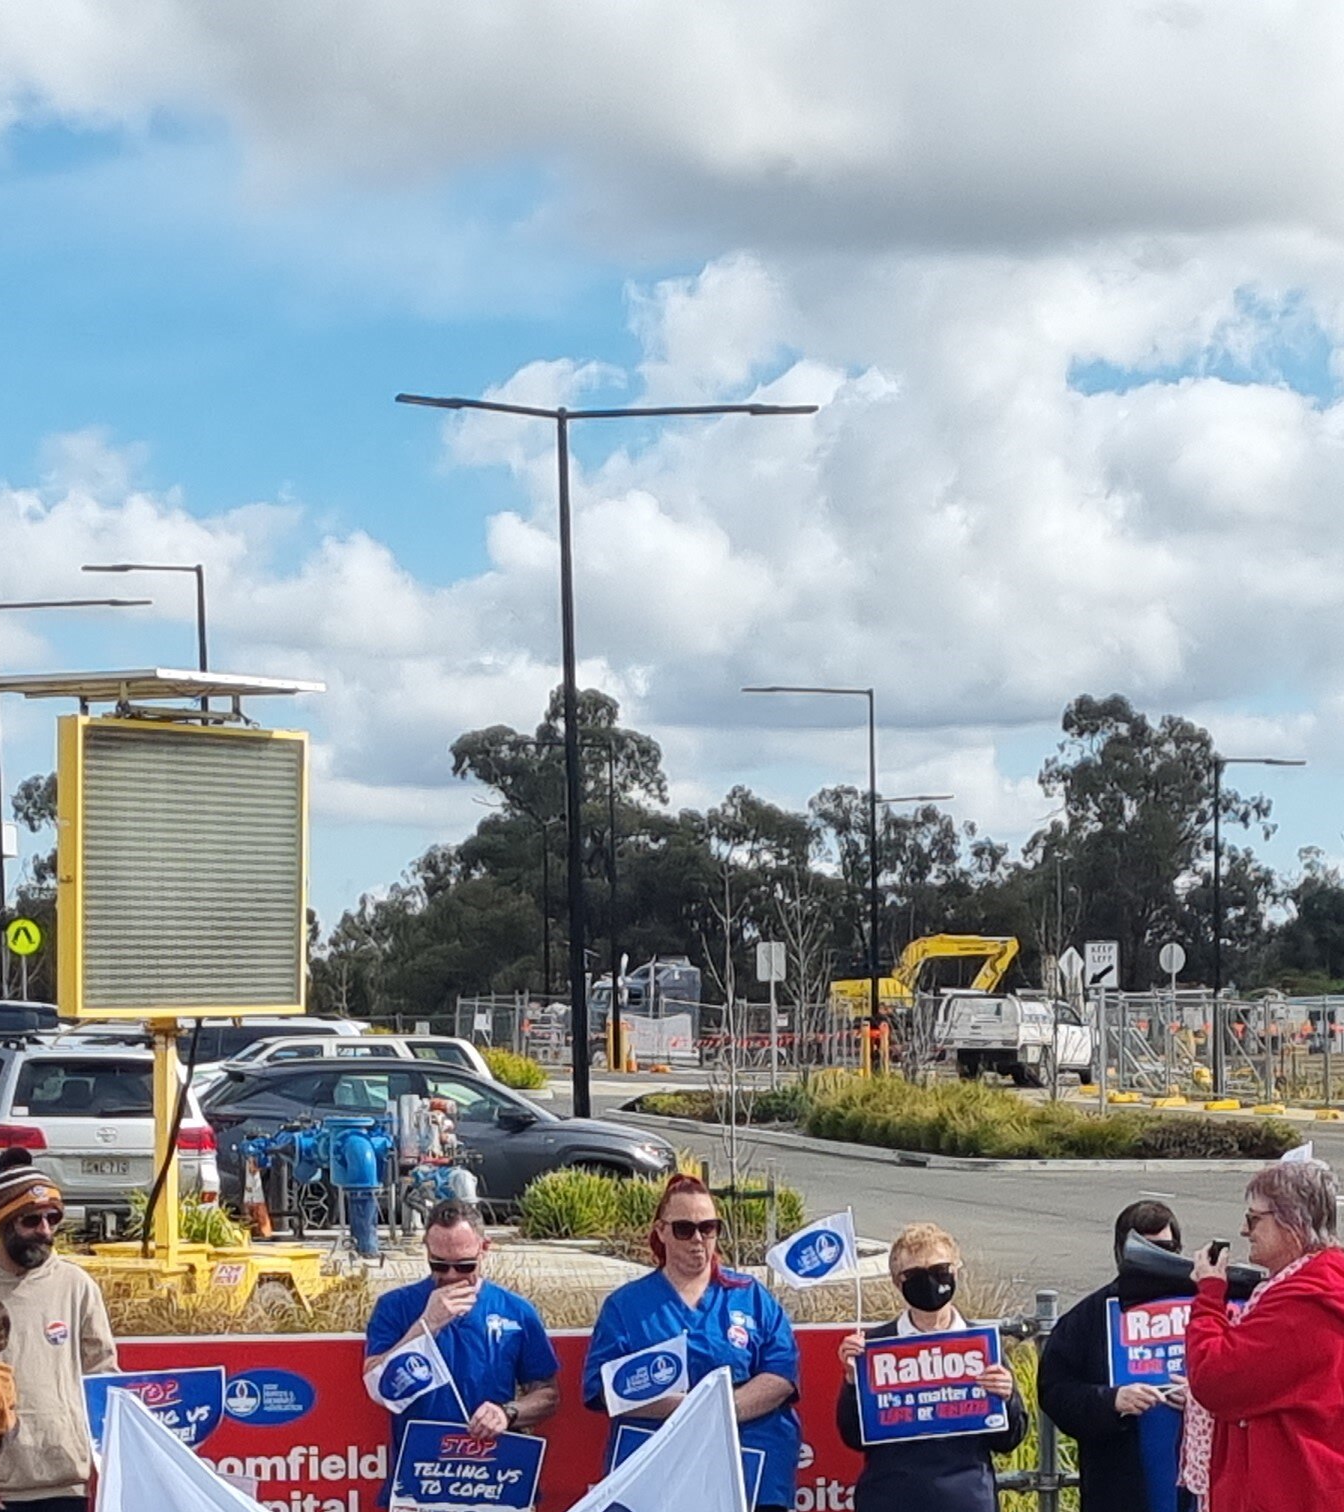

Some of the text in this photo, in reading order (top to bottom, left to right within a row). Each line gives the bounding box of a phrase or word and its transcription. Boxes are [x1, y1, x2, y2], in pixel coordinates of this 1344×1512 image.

[1091, 945, 1114, 953] KEEP
[872, 1346, 986, 1387] Ratios
[917, 1386, 969, 1404] matter
[441, 1437, 498, 1457] STOP
[414, 1462, 523, 1484] TELLING US
[420, 1480, 504, 1500] TO COPE!
